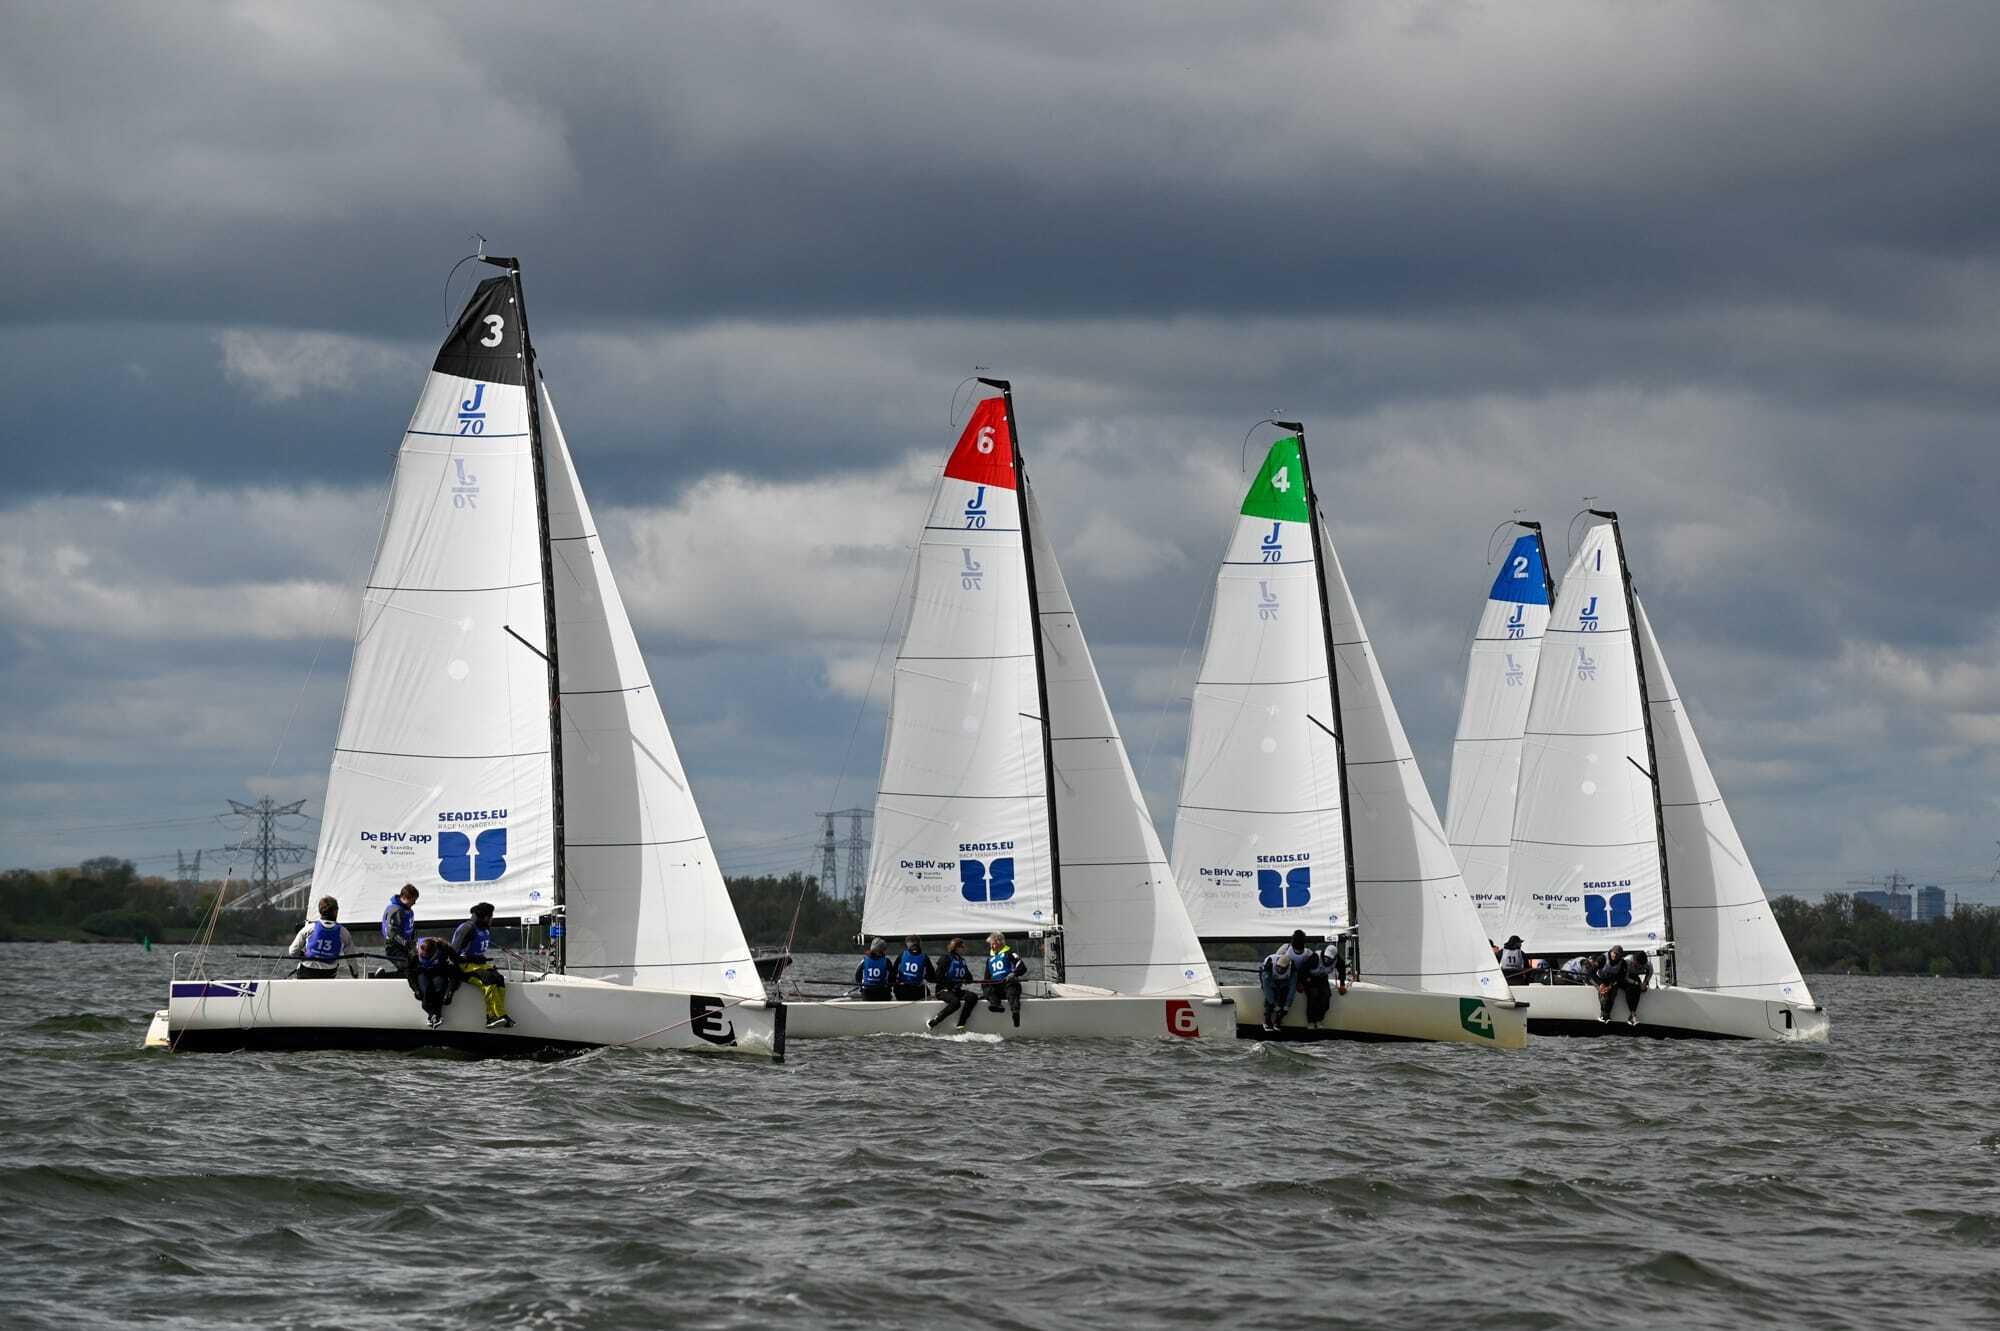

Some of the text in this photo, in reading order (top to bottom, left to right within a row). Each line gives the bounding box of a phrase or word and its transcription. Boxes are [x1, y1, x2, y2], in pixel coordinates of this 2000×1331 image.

[480, 314, 505, 348] 3
[462, 384, 486, 412] J
[460, 420, 485, 435] 70
[977, 426, 995, 454] 6
[1271, 466, 1290, 493] 4
[967, 486, 986, 509] J
[965, 516, 986, 529] 70
[1264, 522, 1282, 544] J
[1263, 551, 1282, 563] 70
[1513, 556, 1528, 579] 2
[1581, 597, 1598, 616] J
[1509, 605, 1524, 624] J
[1580, 621, 1598, 632] 70
[1508, 628, 1524, 639] 70
[438, 809, 508, 822] SEADIS.EU
[360, 831, 432, 844] De BHV app
[959, 841, 1014, 852] SEADIS.EU
[1257, 853, 1310, 863] SEADIS.EU
[900, 860, 955, 871] De BHV app
[1200, 868, 1253, 878] De BHV app
[1583, 879, 1631, 889] SEADIS.EU
[1475, 893, 1492, 901] BHV
[1532, 893, 1544, 901] De
[1545, 894, 1563, 902] BHV
[315, 939, 333, 951] 13
[992, 959, 1004, 972] 10
[1507, 955, 1516, 964] 11
[867, 967, 881, 978] 10
[904, 961, 918, 973] 10
[955, 967, 966, 978] 10
[703, 1005, 732, 1037] 3
[1175, 1007, 1199, 1032] 6
[1467, 1006, 1492, 1030] 4
[1779, 1009, 1792, 1029] 1
